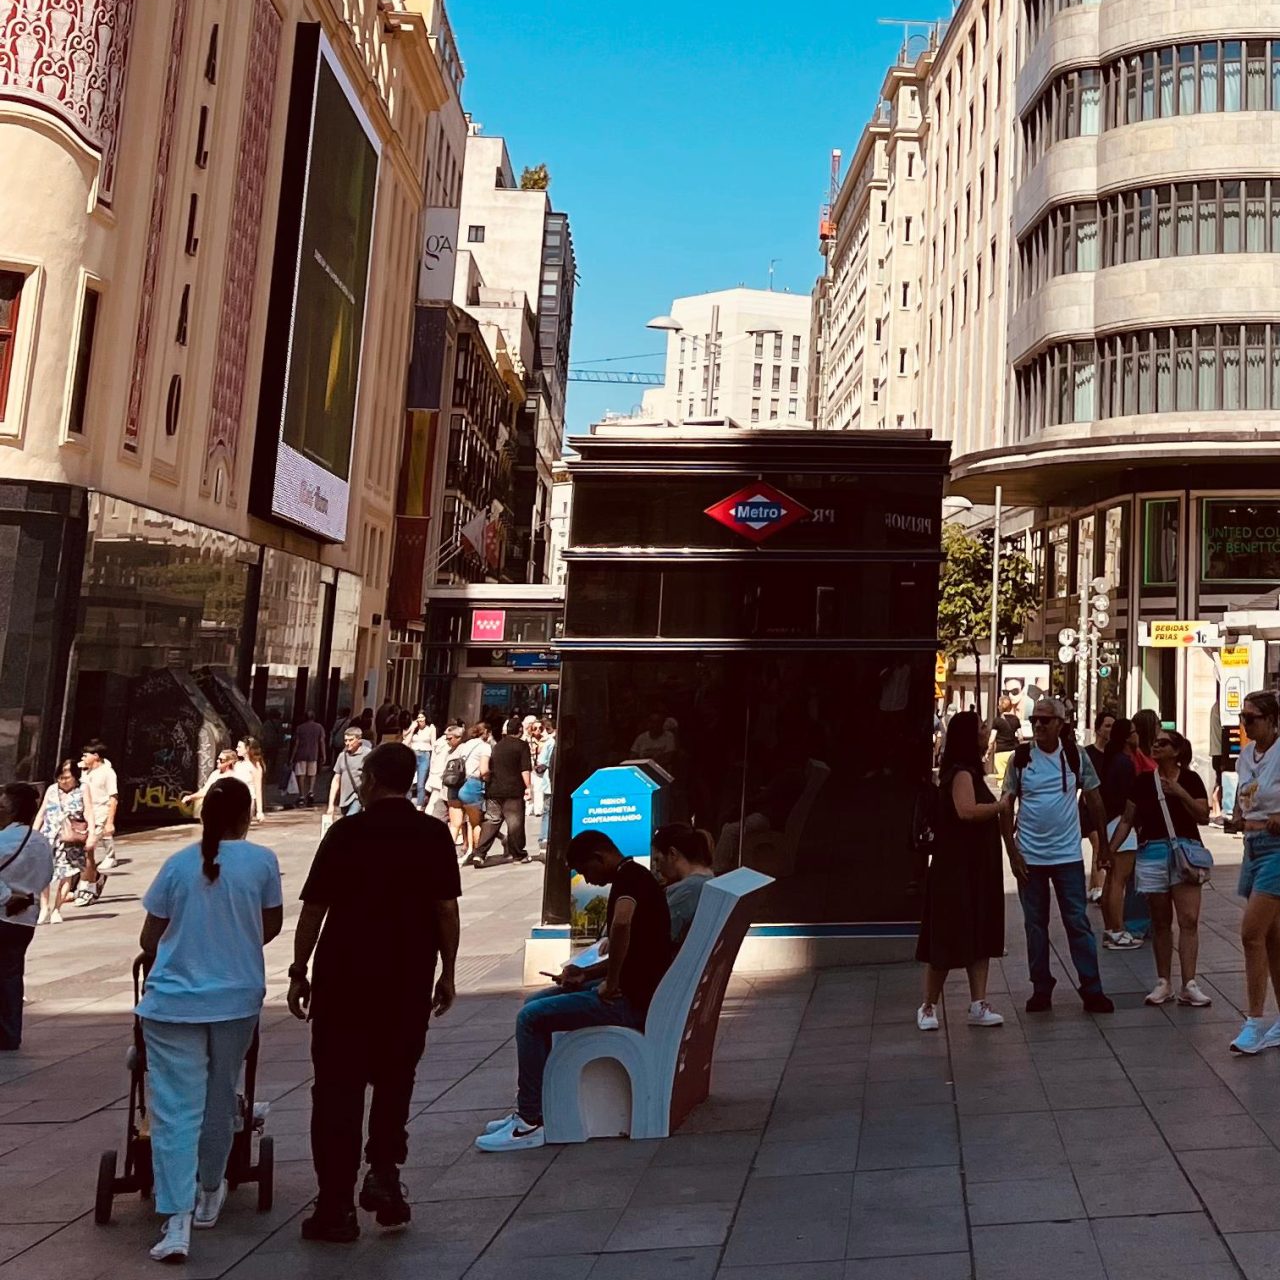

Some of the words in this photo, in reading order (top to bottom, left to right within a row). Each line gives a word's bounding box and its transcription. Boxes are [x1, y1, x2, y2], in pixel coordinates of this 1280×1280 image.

[737, 505, 778, 519] Metro
[1207, 526, 1252, 538] UNITED
[1207, 542, 1223, 553] OF
[588, 806, 637, 815] FURGONETAS
[582, 814, 642, 824] CONTAMINANDO
